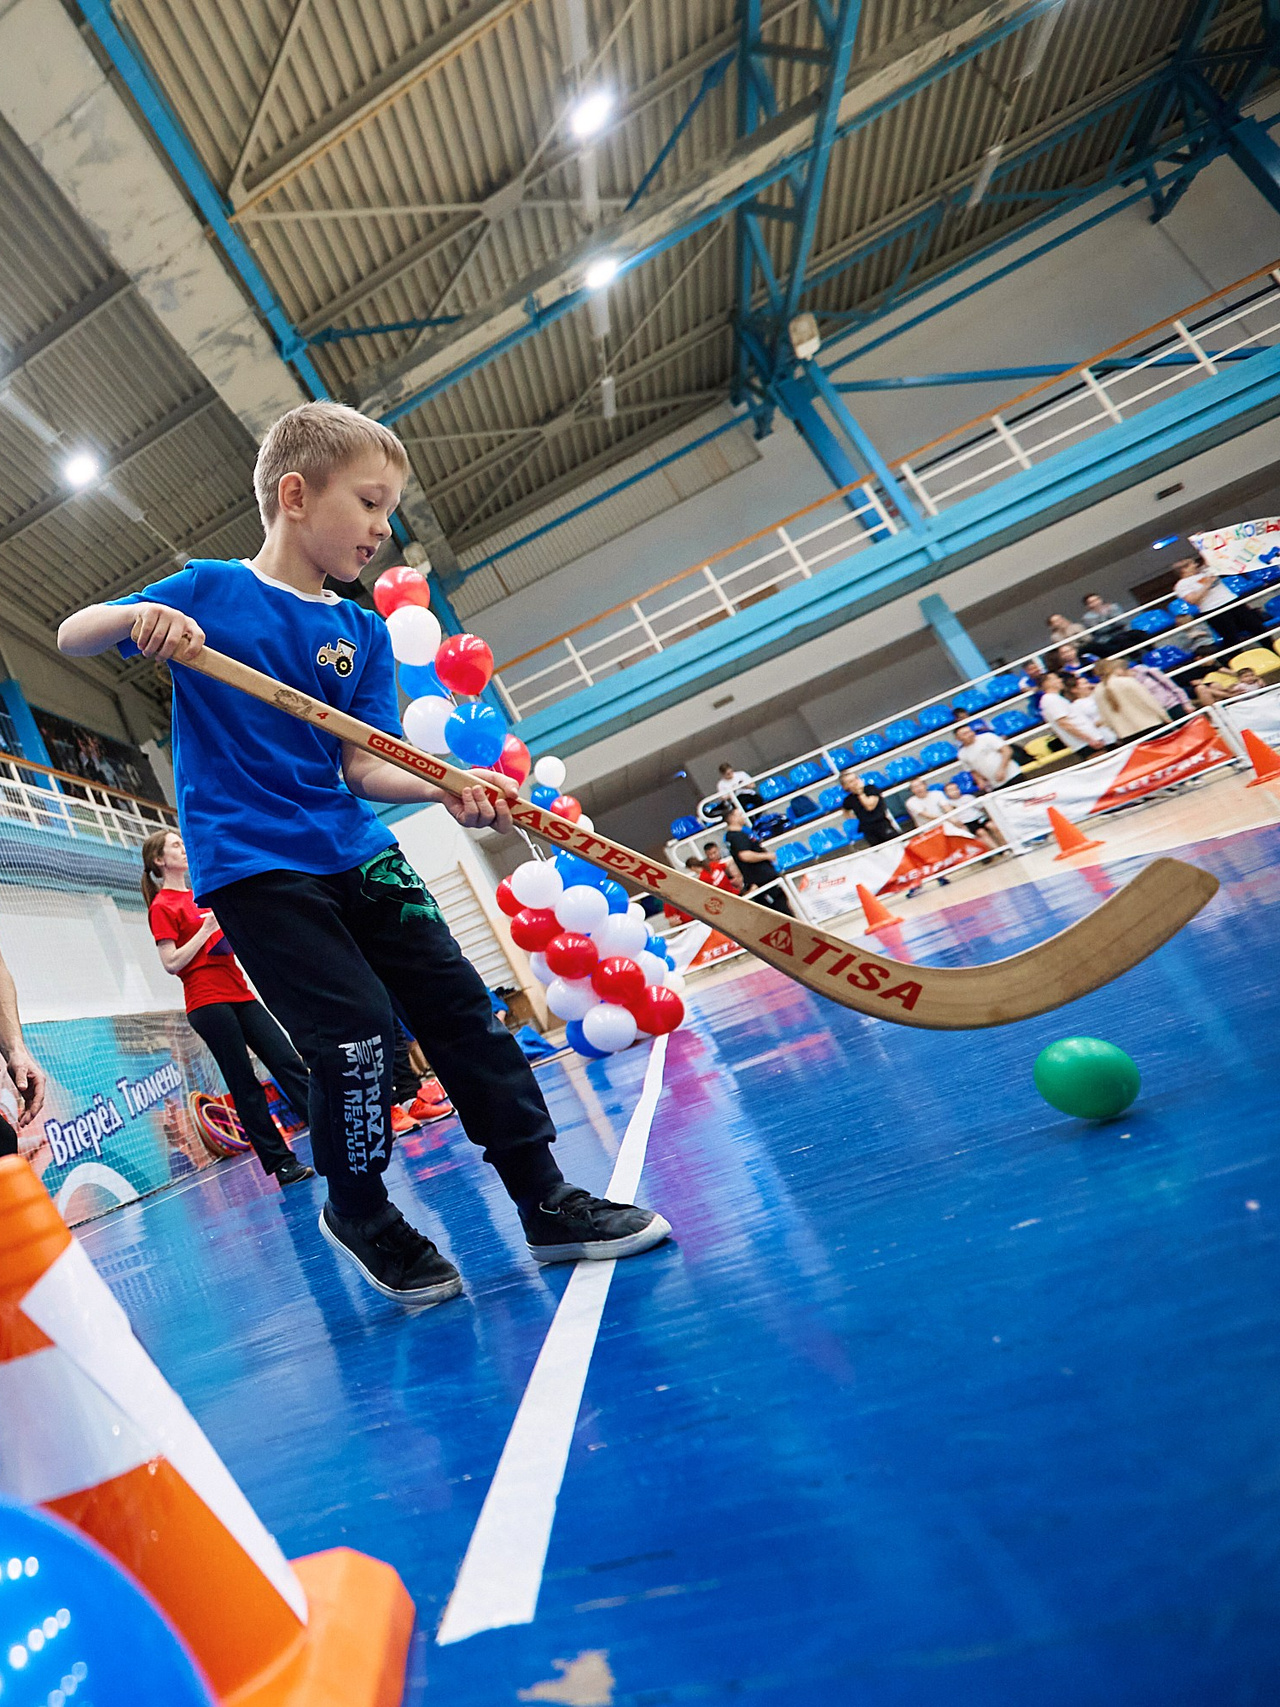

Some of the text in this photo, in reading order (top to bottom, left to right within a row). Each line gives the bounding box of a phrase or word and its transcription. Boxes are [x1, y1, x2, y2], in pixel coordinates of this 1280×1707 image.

[371, 736, 443, 777] CUSTOM
[802, 936, 923, 1011] TISA
[44, 1062, 184, 1168] Вперёд Тюмень
[343, 1089, 368, 1173] REALITY
[345, 1127, 358, 1176] JUST
